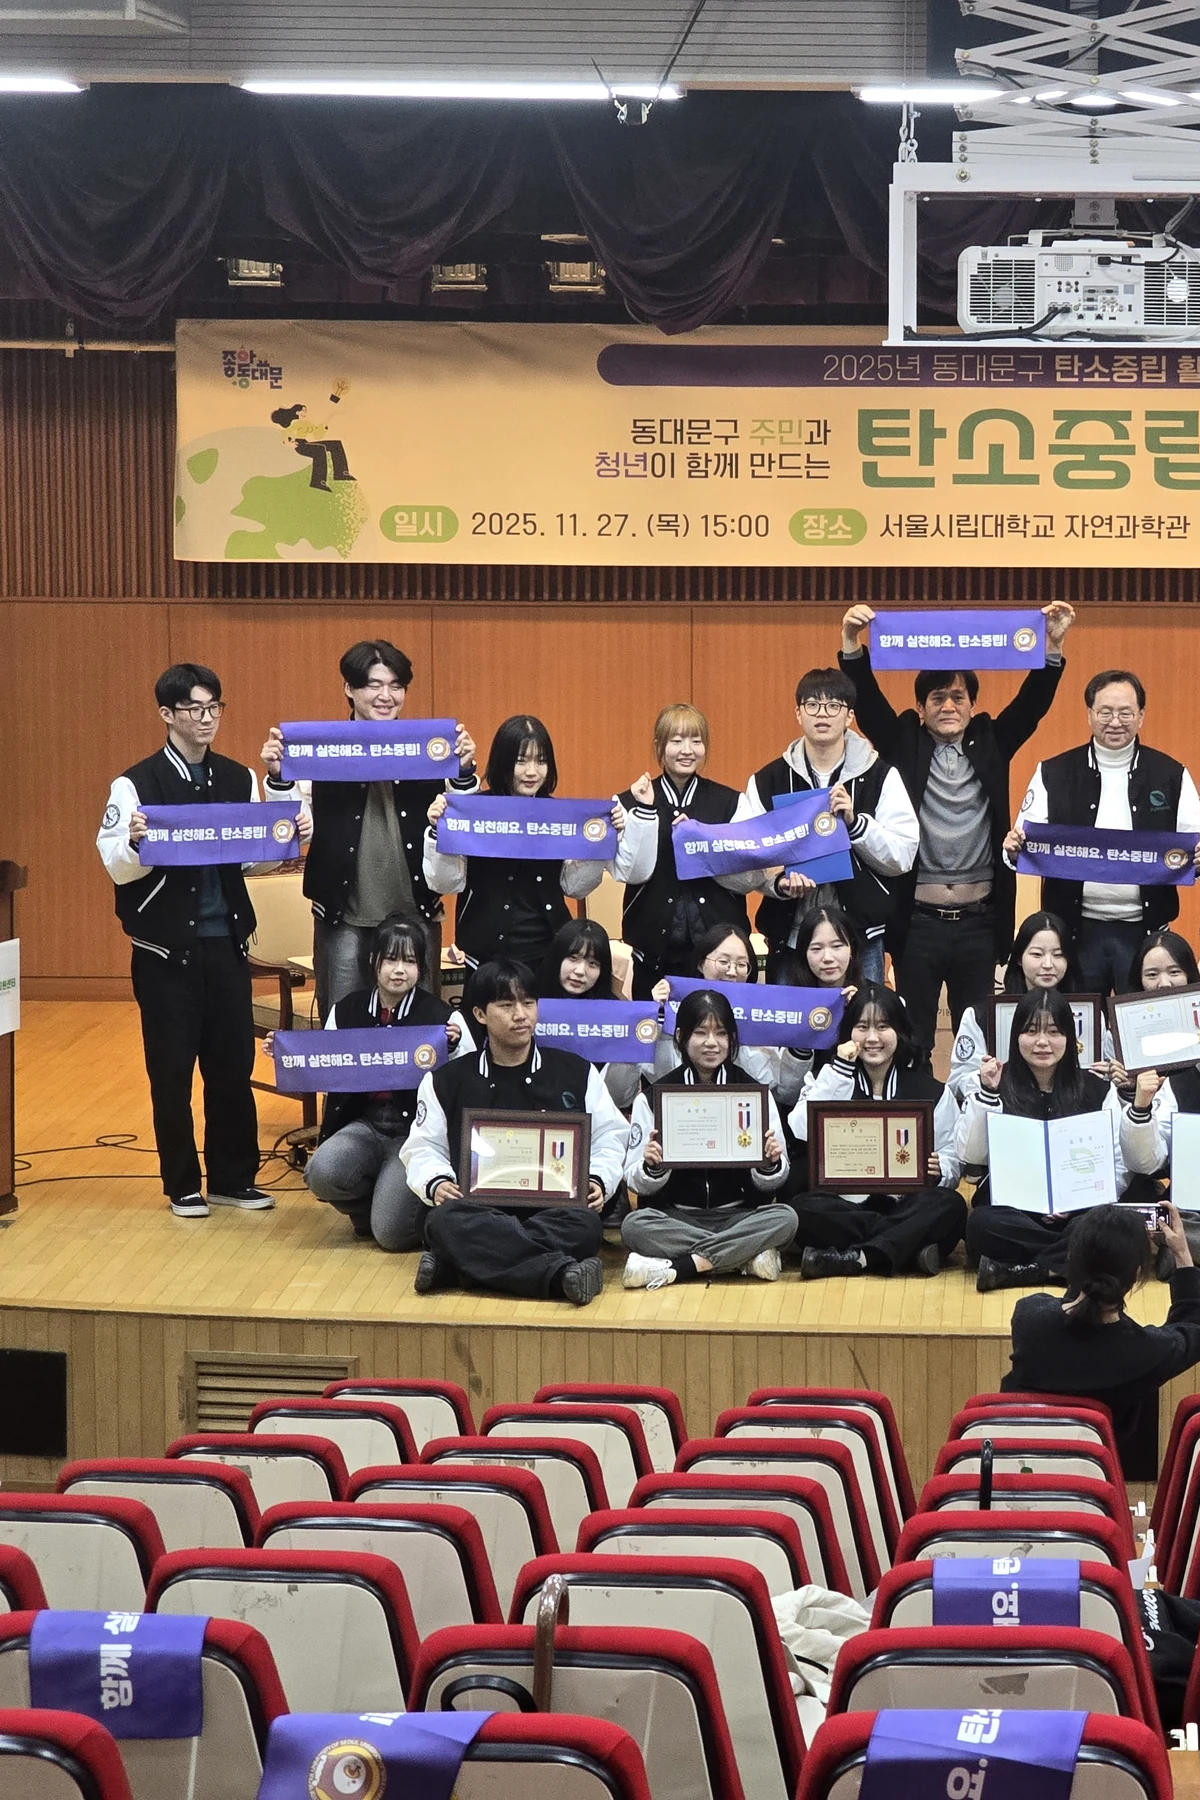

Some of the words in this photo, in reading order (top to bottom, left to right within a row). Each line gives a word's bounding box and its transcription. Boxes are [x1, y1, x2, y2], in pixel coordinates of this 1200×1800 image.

[823, 354, 921, 381] 2025년
[932, 354, 1044, 382] 동대문구
[1054, 354, 1167, 383] 탄소중립
[630, 418, 740, 446] 동대문구
[749, 418, 832, 446] 주민과
[594, 451, 676, 479] 청년이
[686, 452, 739, 479] 함께
[749, 453, 831, 480] 만드는
[393, 511, 444, 538] 일시
[471, 512, 546, 536] 2025.
[555, 512, 588, 537] 11.
[597, 512, 637, 538] 27.
[647, 512, 690, 538] (목)
[700, 513, 770, 538] 15:00
[802, 513, 853, 541] 장소
[879, 513, 1056, 539] 서울시립대학교
[1064, 514, 1191, 540] 자연과학관
[879, 634, 904, 648] 함께
[906, 634, 956, 648] 실천해요.
[958, 634, 1008, 648] 탄소중립!
[287, 743, 314, 758] 함께
[315, 743, 367, 758] 실천해요.
[370, 743, 421, 757] 탄소중립!
[146, 828, 169, 842] 함께
[171, 827, 218, 842] 실천해요.
[221, 825, 268, 840] 탄소중립!
[446, 817, 470, 832] 함께
[472, 819, 524, 835] 실천해요.
[526, 821, 577, 837] 탄소중립!
[683, 840, 710, 855] 함께
[711, 835, 761, 854] 실천해요.
[761, 823, 810, 849] 탄소중립!
[1026, 840, 1051, 855] 함께
[1053, 843, 1104, 861] 실천해요.
[1106, 848, 1158, 864] 탄소중립!
[750, 1008, 803, 1024] 탄소중립!
[534, 1022, 575, 1037] 천해요.
[577, 1023, 630, 1038] 탄소중립!
[281, 1054, 306, 1069] 함께
[308, 1053, 358, 1068] 실천해요.
[360, 1050, 409, 1066] 탄소중립!
[99, 1643, 133, 1711] 함께
